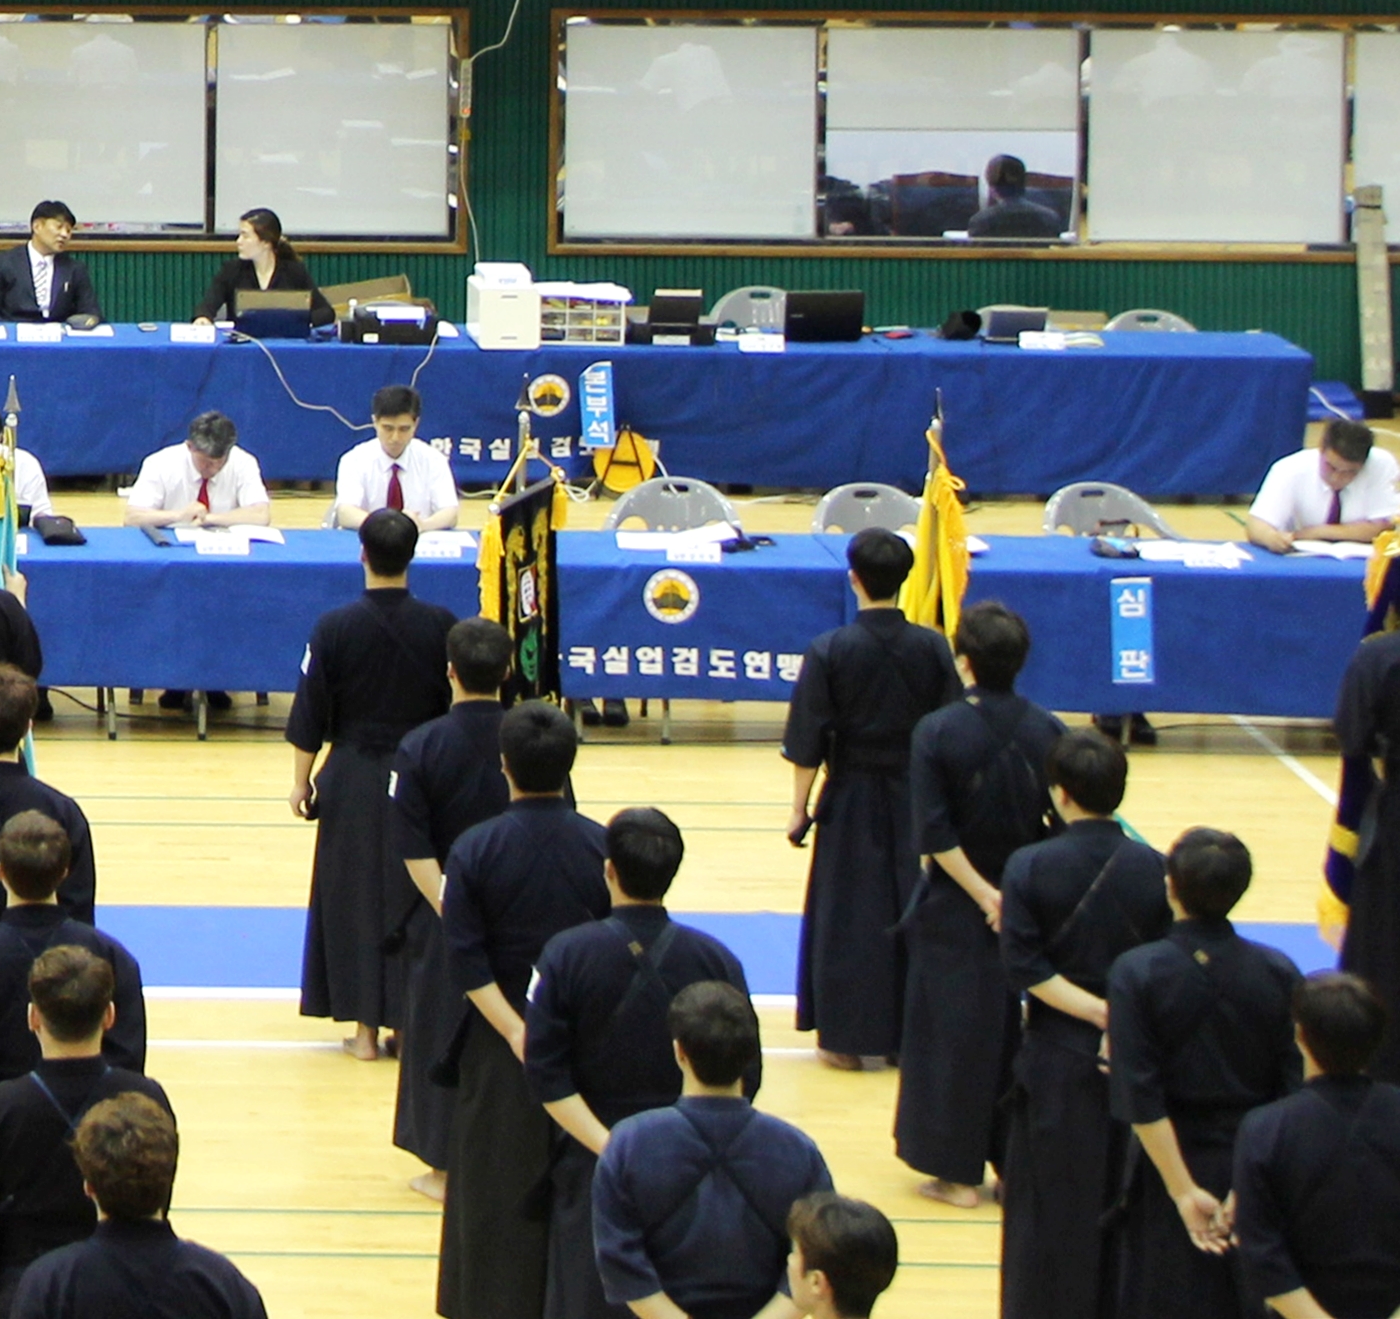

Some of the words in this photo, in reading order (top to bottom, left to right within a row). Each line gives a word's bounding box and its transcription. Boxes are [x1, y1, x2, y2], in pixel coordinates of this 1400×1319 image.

[584, 370, 610, 444] 본부석
[558, 646, 804, 682] 국실업검도연맹
[1117, 588, 1149, 678] 심판
